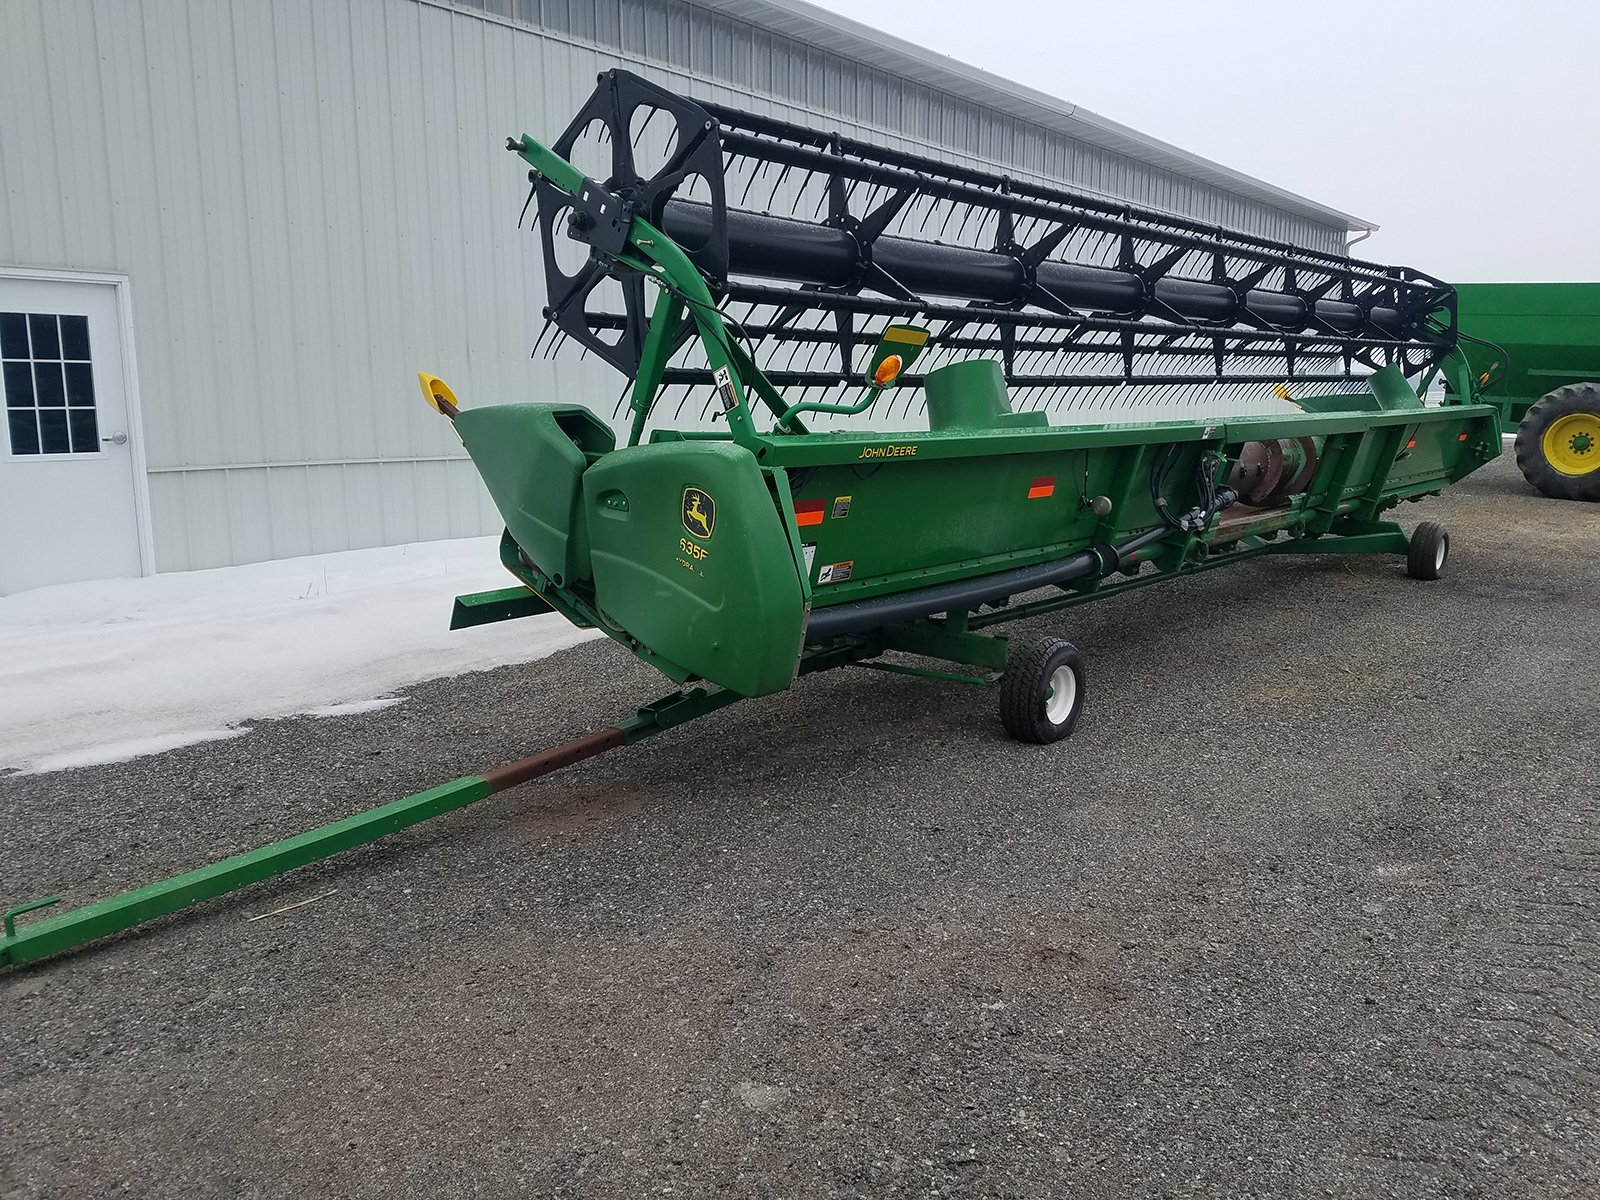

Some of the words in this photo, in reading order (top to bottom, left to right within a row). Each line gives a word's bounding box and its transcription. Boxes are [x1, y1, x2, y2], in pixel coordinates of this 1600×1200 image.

[858, 446, 887, 459] JOHN
[886, 445, 918, 457] DEERE
[679, 537, 709, 561] 635F
